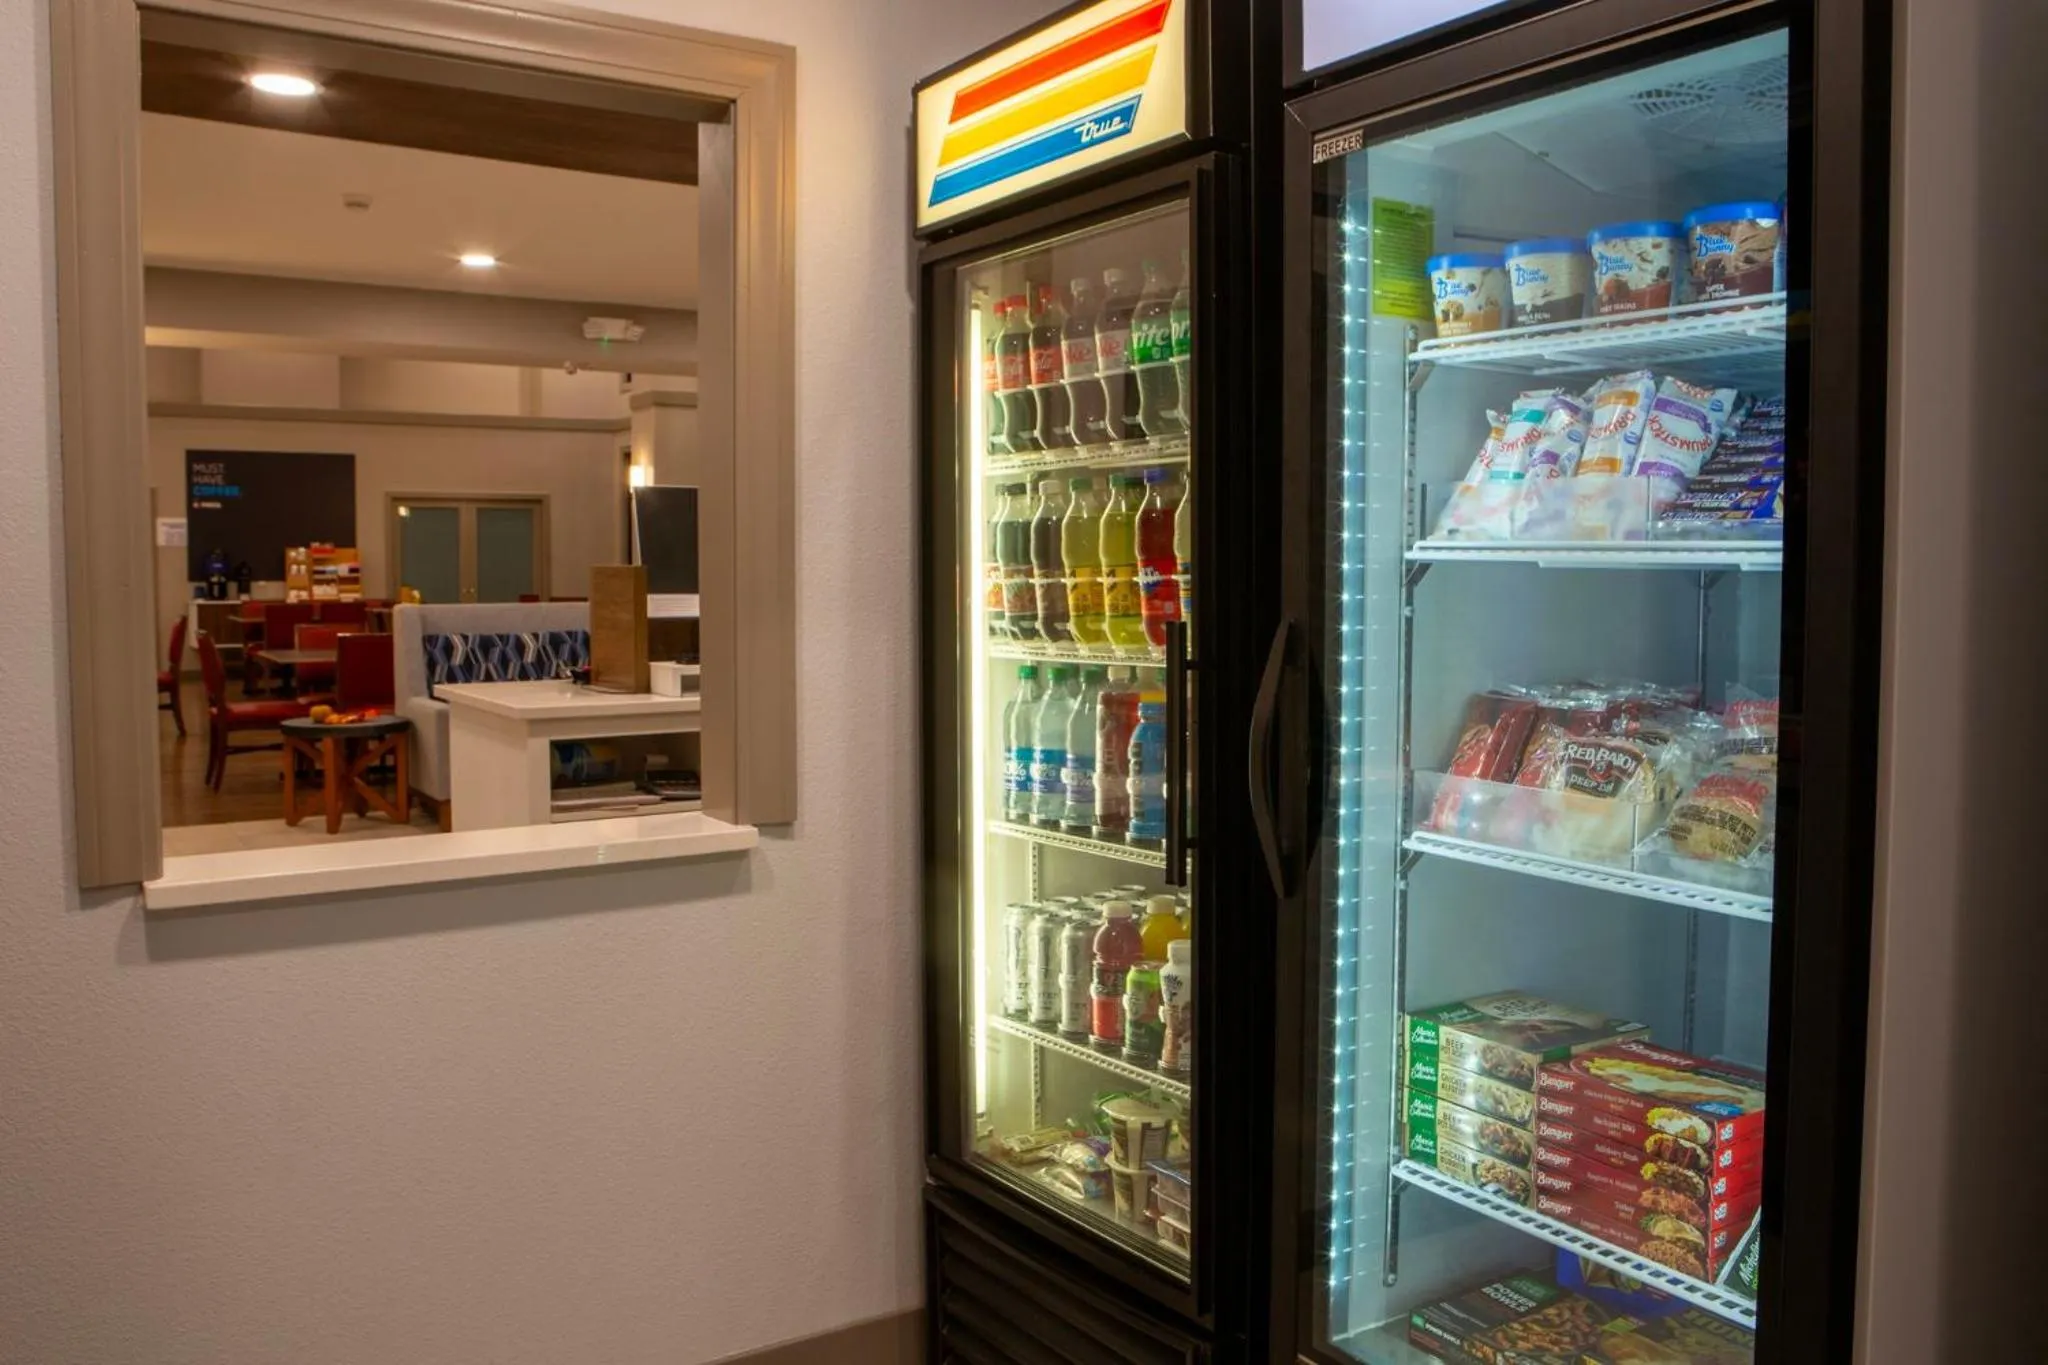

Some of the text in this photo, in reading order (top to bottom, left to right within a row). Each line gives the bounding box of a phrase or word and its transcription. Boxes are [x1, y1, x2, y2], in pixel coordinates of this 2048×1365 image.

[1314, 132, 1363, 159] FREEZER
[1131, 323, 1170, 349] rite
[1648, 413, 1714, 453] DRUMSTICK
[1564, 743, 1596, 762] RED
